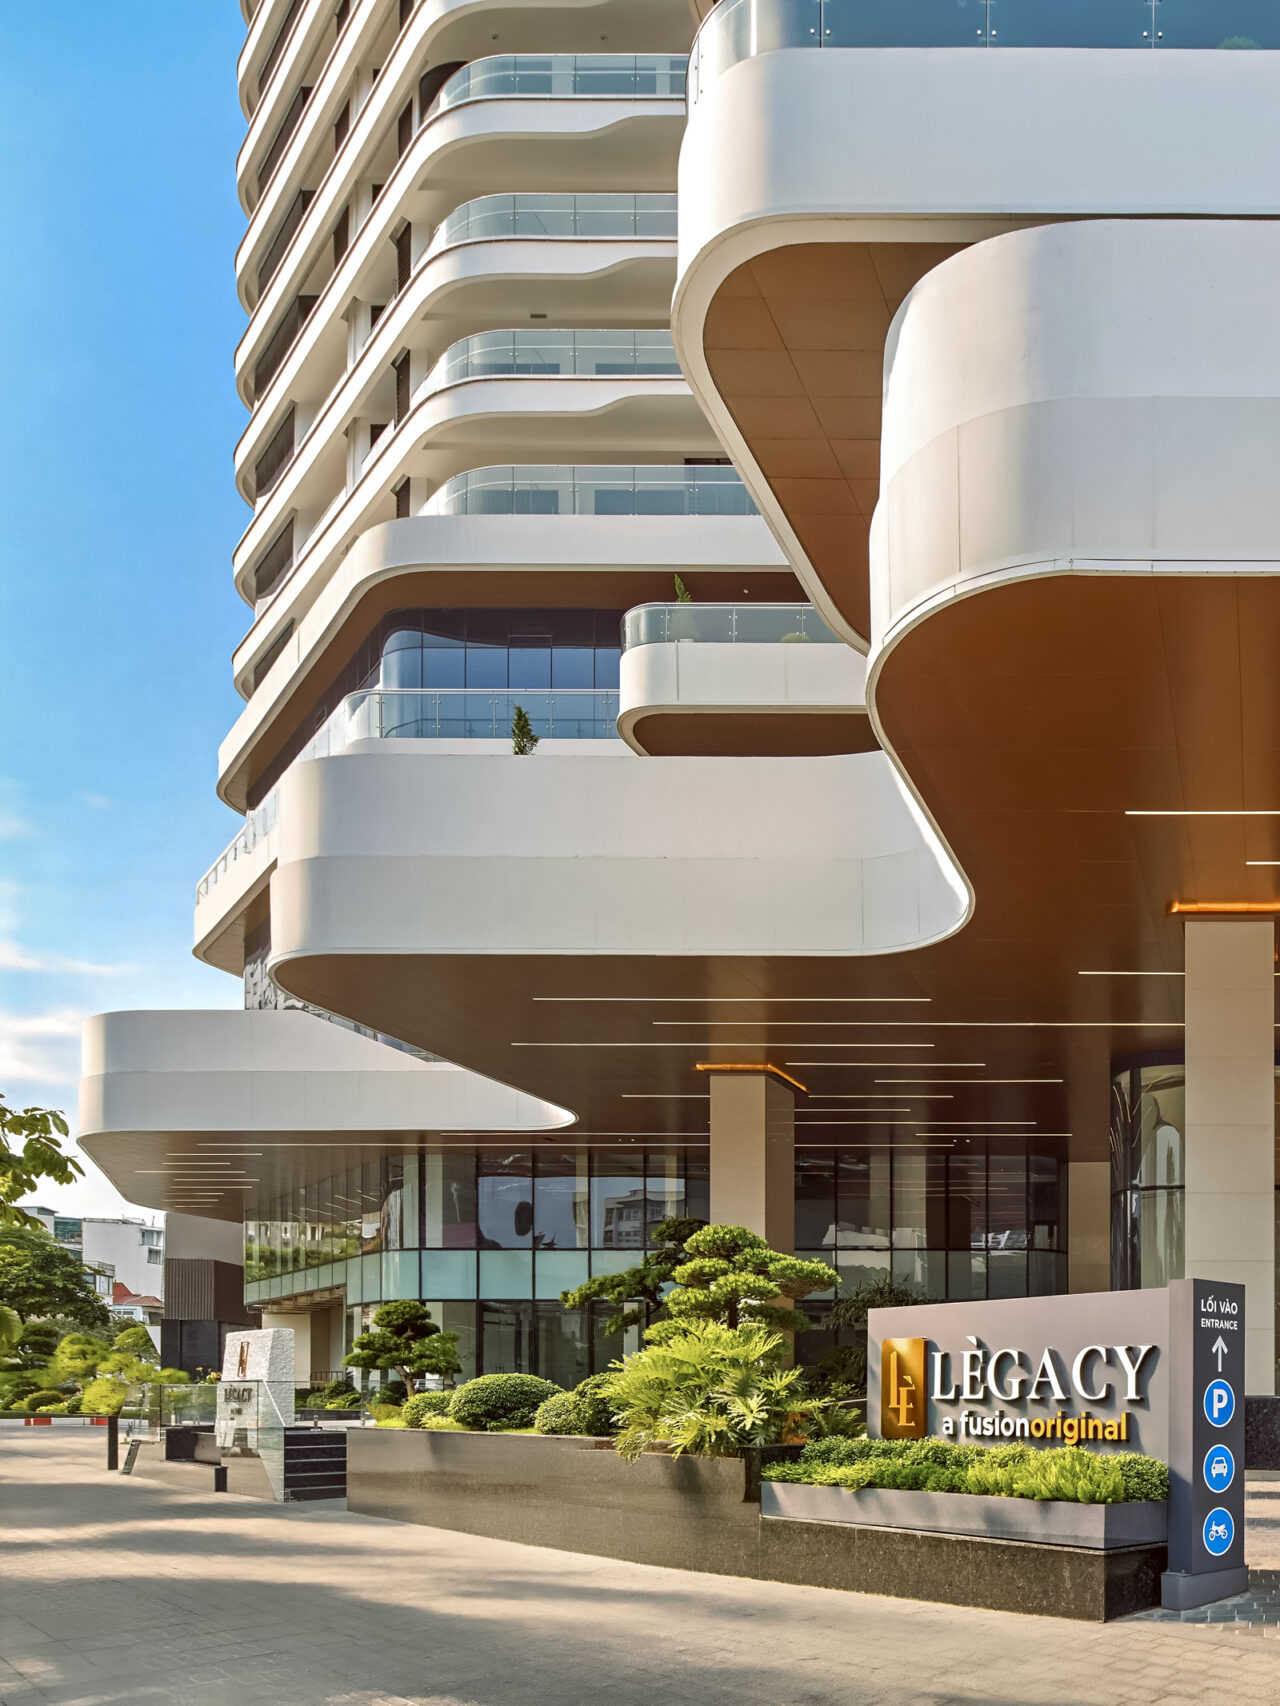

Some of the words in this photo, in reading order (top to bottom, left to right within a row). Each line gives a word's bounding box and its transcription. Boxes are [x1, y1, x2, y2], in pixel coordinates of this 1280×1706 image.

[1201, 1294, 1217, 1313] LỐI
[1219, 1298, 1238, 1315] VÀO
[1201, 1317, 1238, 1331] ENTRANCE
[931, 1335, 1153, 1401] LÈGACY
[1213, 1388, 1228, 1418] P
[942, 1416, 954, 1436] a
[960, 1410, 1128, 1446] fusionoriginal
